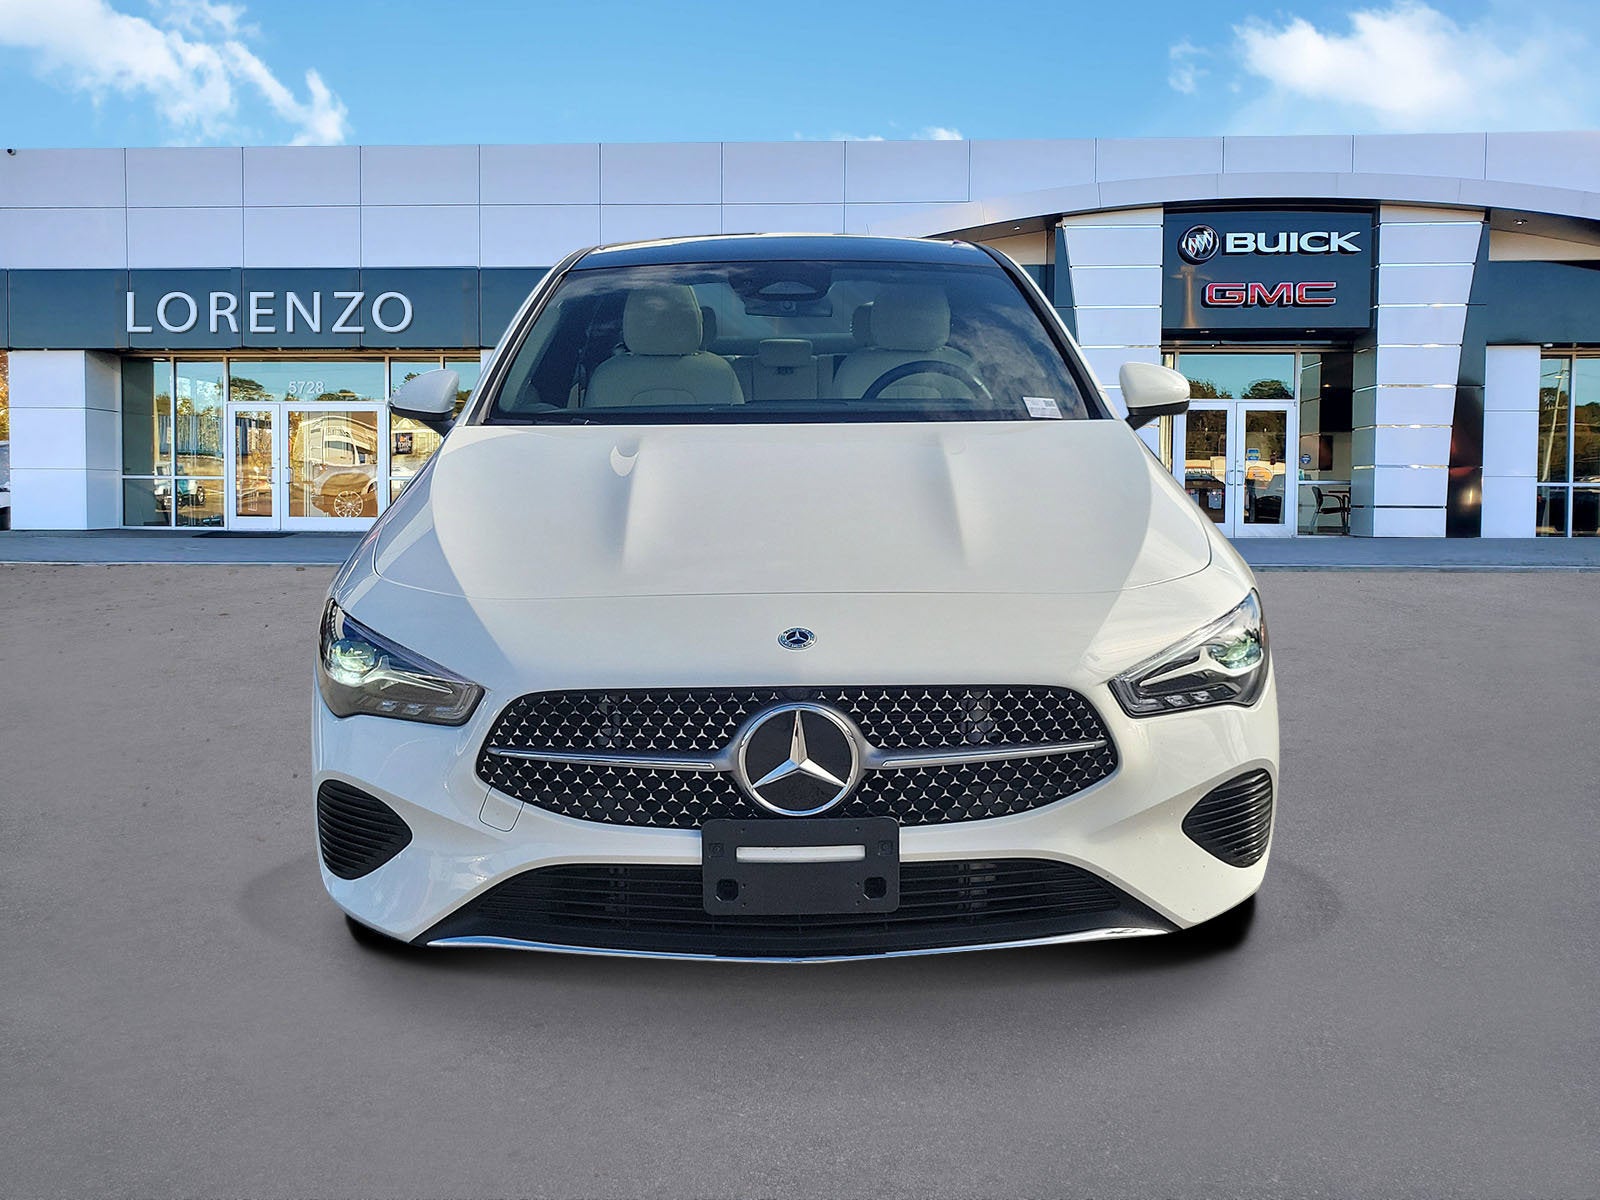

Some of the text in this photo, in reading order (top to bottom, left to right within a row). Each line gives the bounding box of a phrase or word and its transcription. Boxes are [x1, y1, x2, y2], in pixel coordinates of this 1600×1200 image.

[1226, 231, 1362, 253] BUICK
[1206, 282, 1337, 305] GMC
[126, 291, 413, 333] LORENZO
[288, 381, 325, 394] 5728
